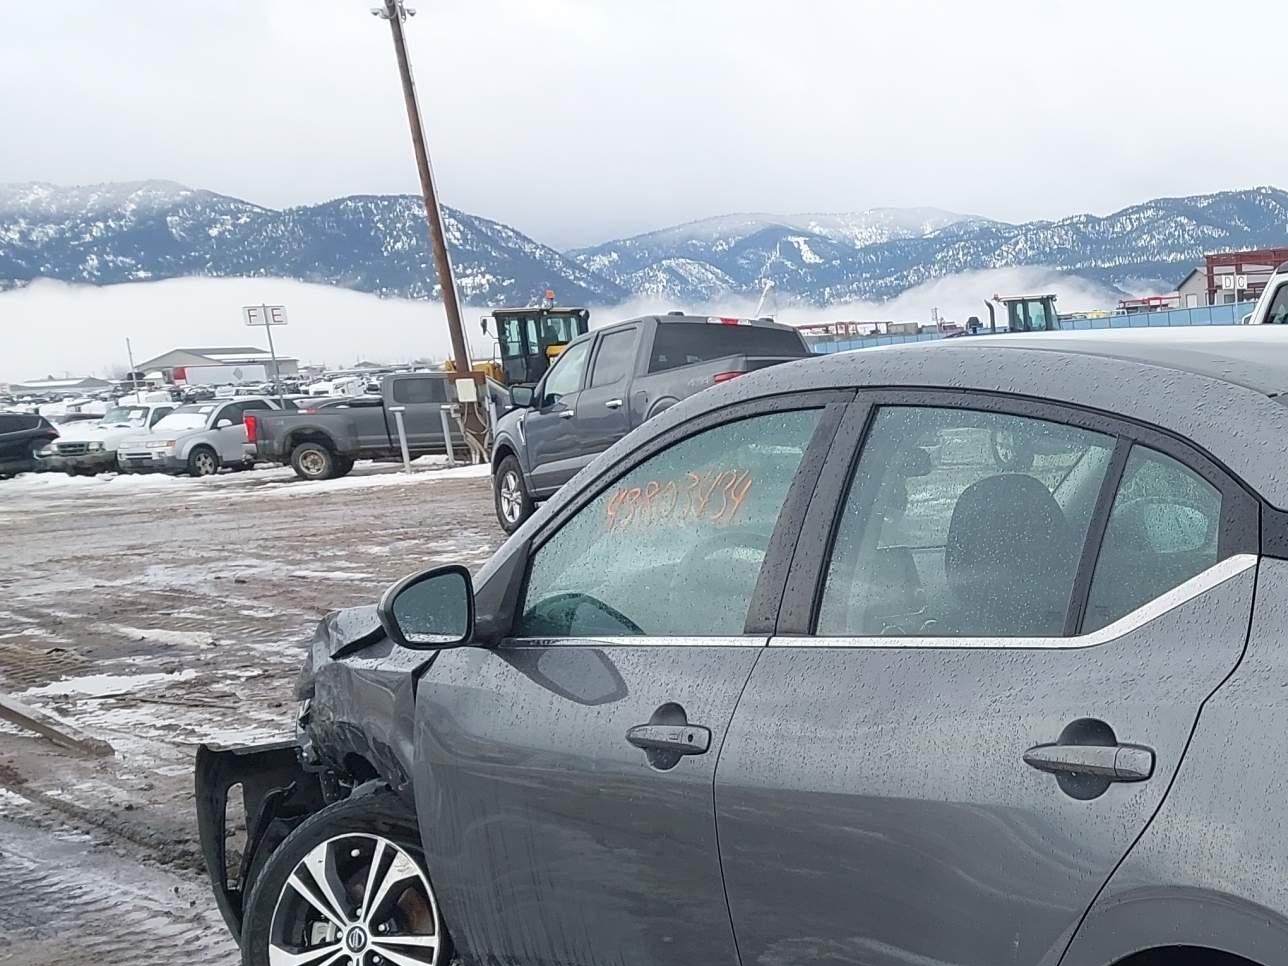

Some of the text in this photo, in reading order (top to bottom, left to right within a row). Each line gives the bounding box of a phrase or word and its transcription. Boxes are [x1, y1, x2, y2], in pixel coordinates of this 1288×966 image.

[1225, 276, 1232, 288] D
[247, 308, 284, 323] F E
